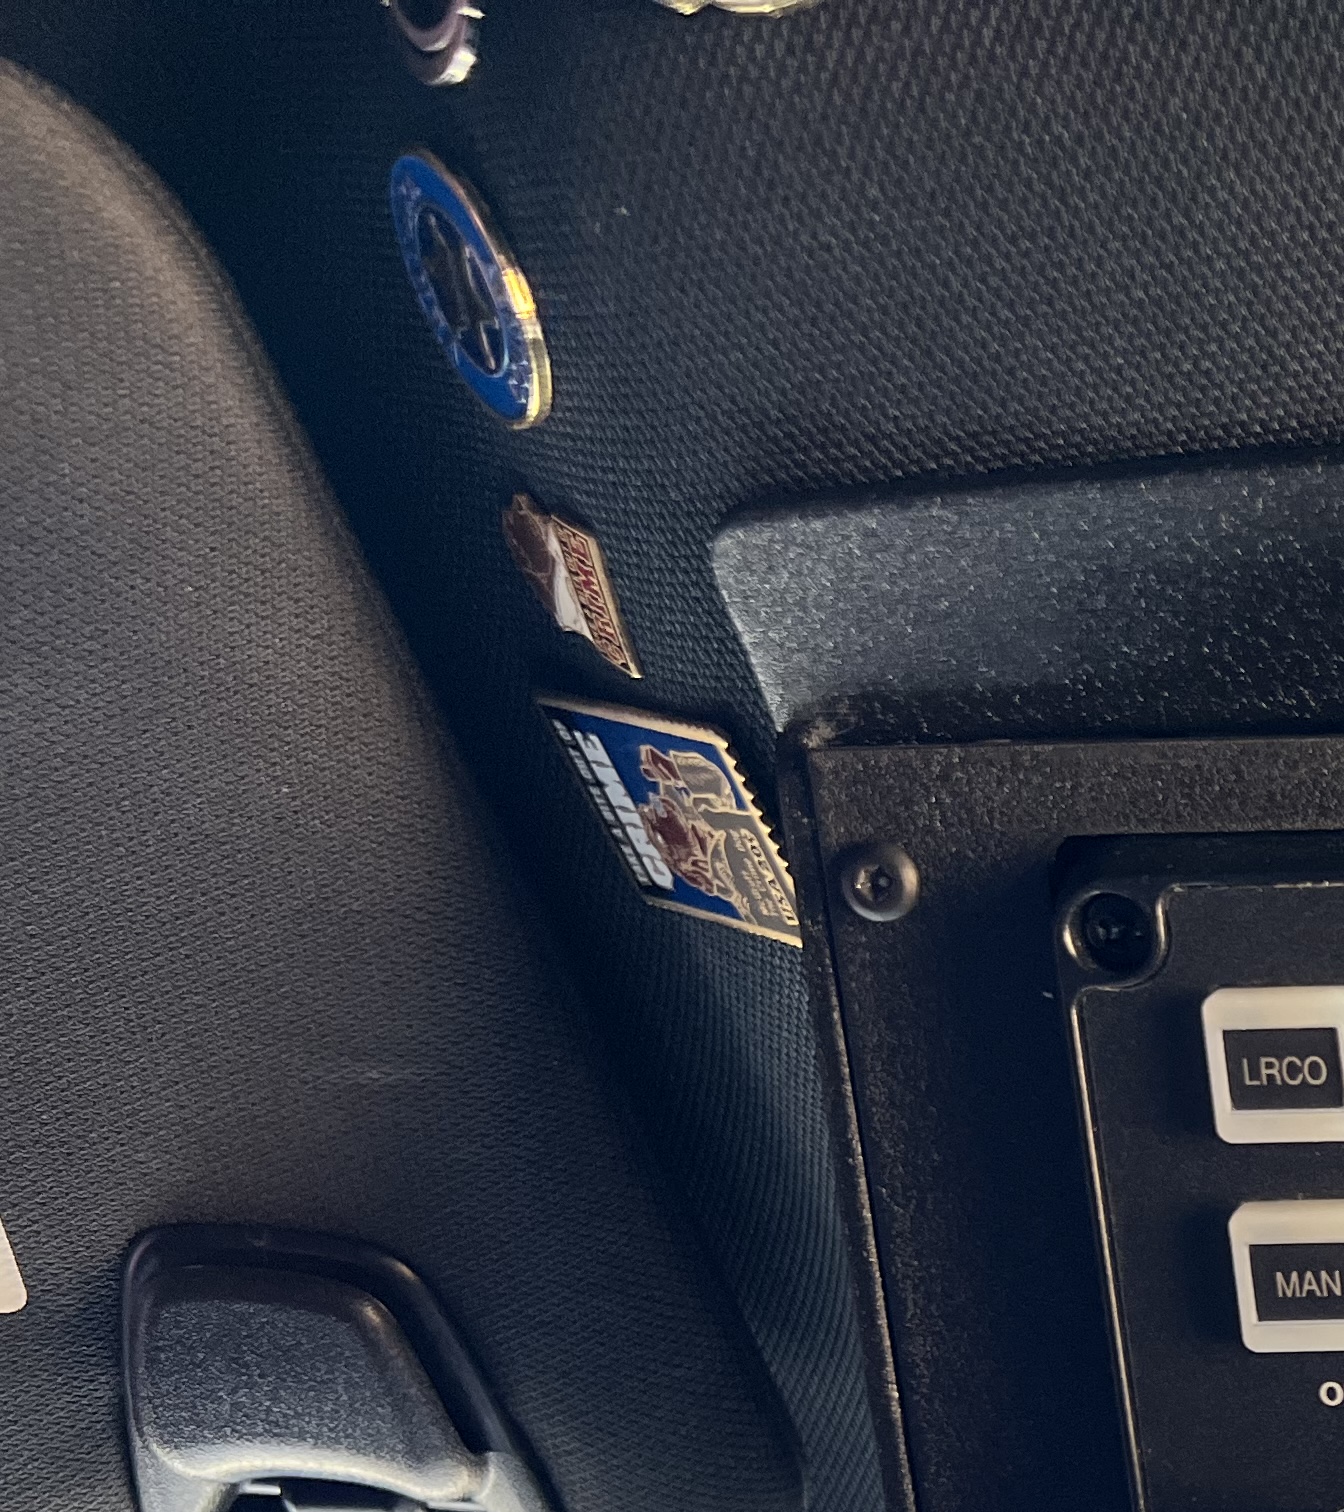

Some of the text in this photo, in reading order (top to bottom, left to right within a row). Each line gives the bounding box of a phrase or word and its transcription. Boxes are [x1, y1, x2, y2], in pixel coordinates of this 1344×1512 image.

[573, 729, 674, 890] CRIME
[1242, 1055, 1328, 1086] LRCO
[1275, 1269, 1342, 1298] MAN
